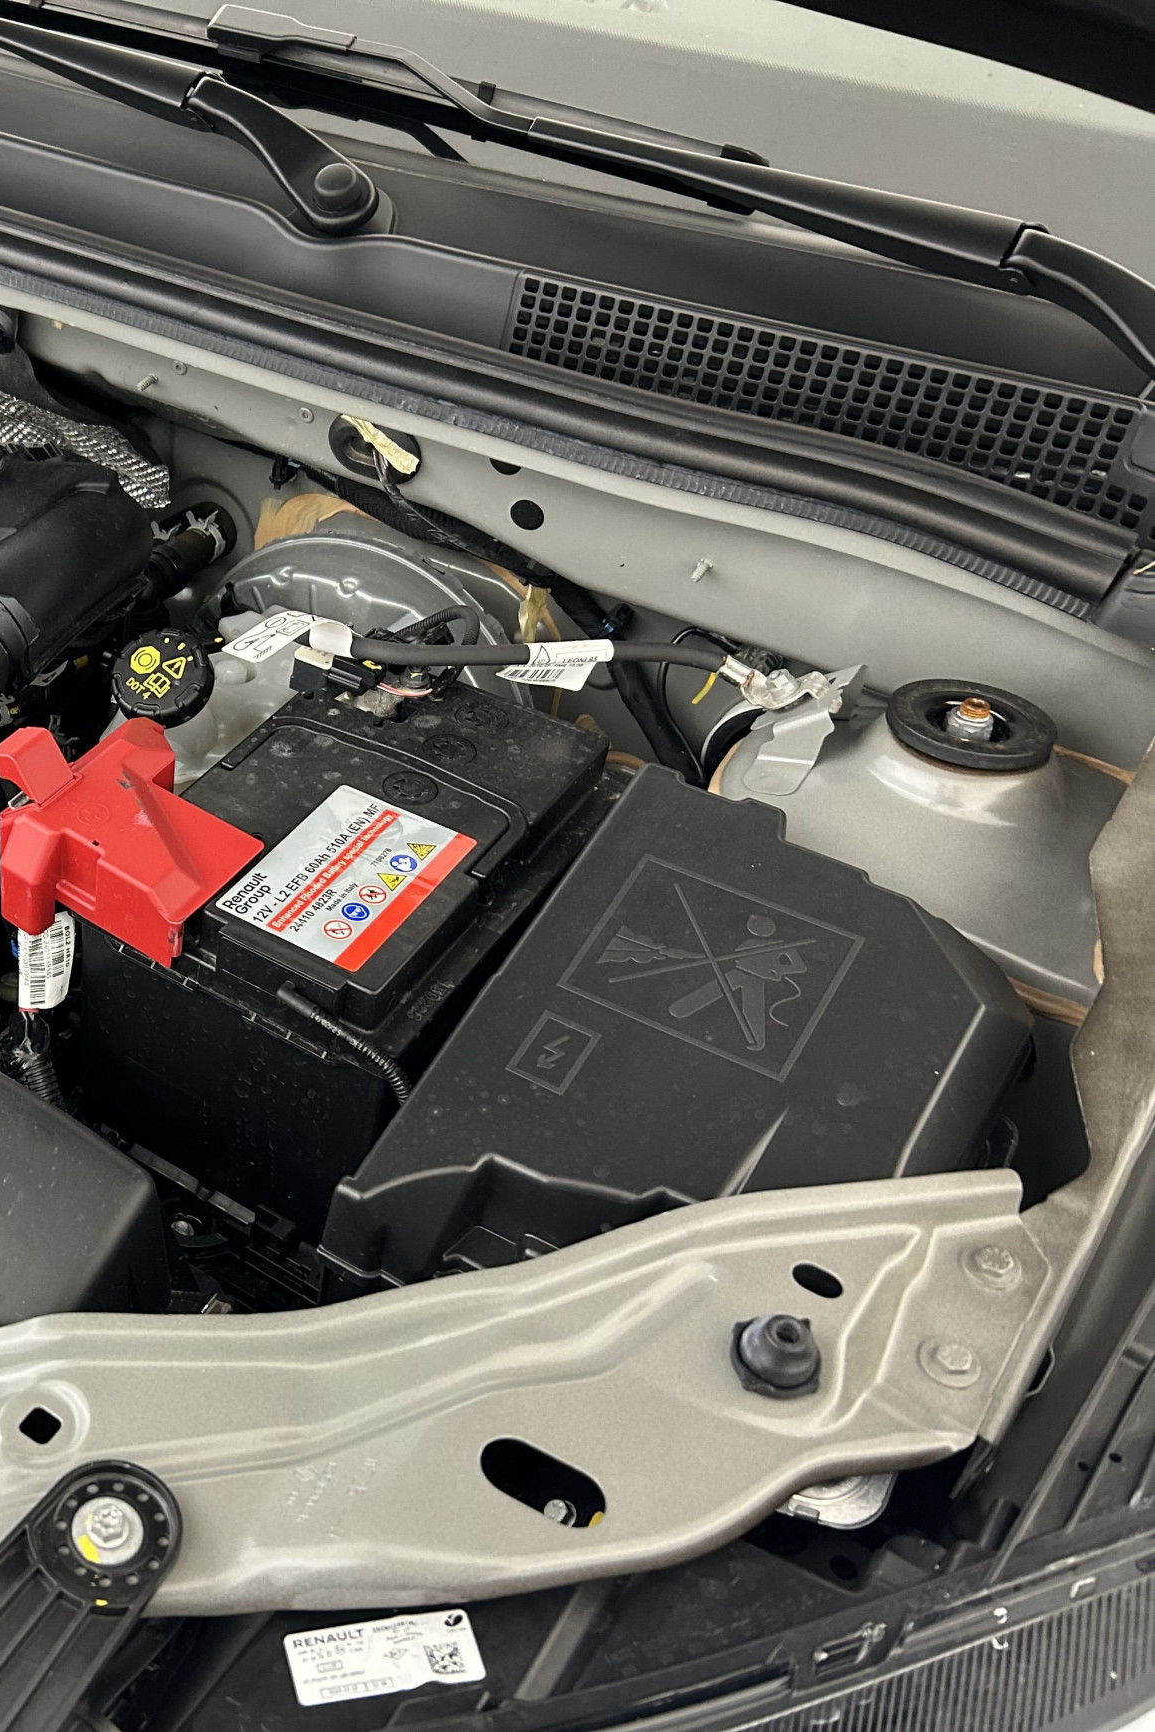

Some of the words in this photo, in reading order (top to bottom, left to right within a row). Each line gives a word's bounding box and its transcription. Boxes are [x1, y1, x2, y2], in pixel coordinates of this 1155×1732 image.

[125, 677, 145, 694] DOT
[142, 691, 152, 700] 4
[253, 902, 275, 923] 12V
[276, 889, 292, 907] L2
[285, 872, 310, 898] EFB
[304, 851, 331, 876] 60Ah
[326, 831, 351, 855] 510A
[345, 812, 371, 837] (EN)
[365, 803, 380, 819] MF
[271, 898, 304, 929] Enhanced
[299, 875, 327, 905] Flooded
[324, 857, 346, 880] Battery
[343, 838, 365, 863] special
[360, 813, 395, 846] technology
[222, 872, 268, 912] Renault
[235, 884, 272, 915] Group
[339, 890, 349, 902] in
[343, 881, 359, 897] Italy
[289, 907, 316, 933] 24410
[312, 888, 338, 915] 4823R
[326, 896, 342, 912] Made
[292, 1627, 364, 1649] RENAULT
